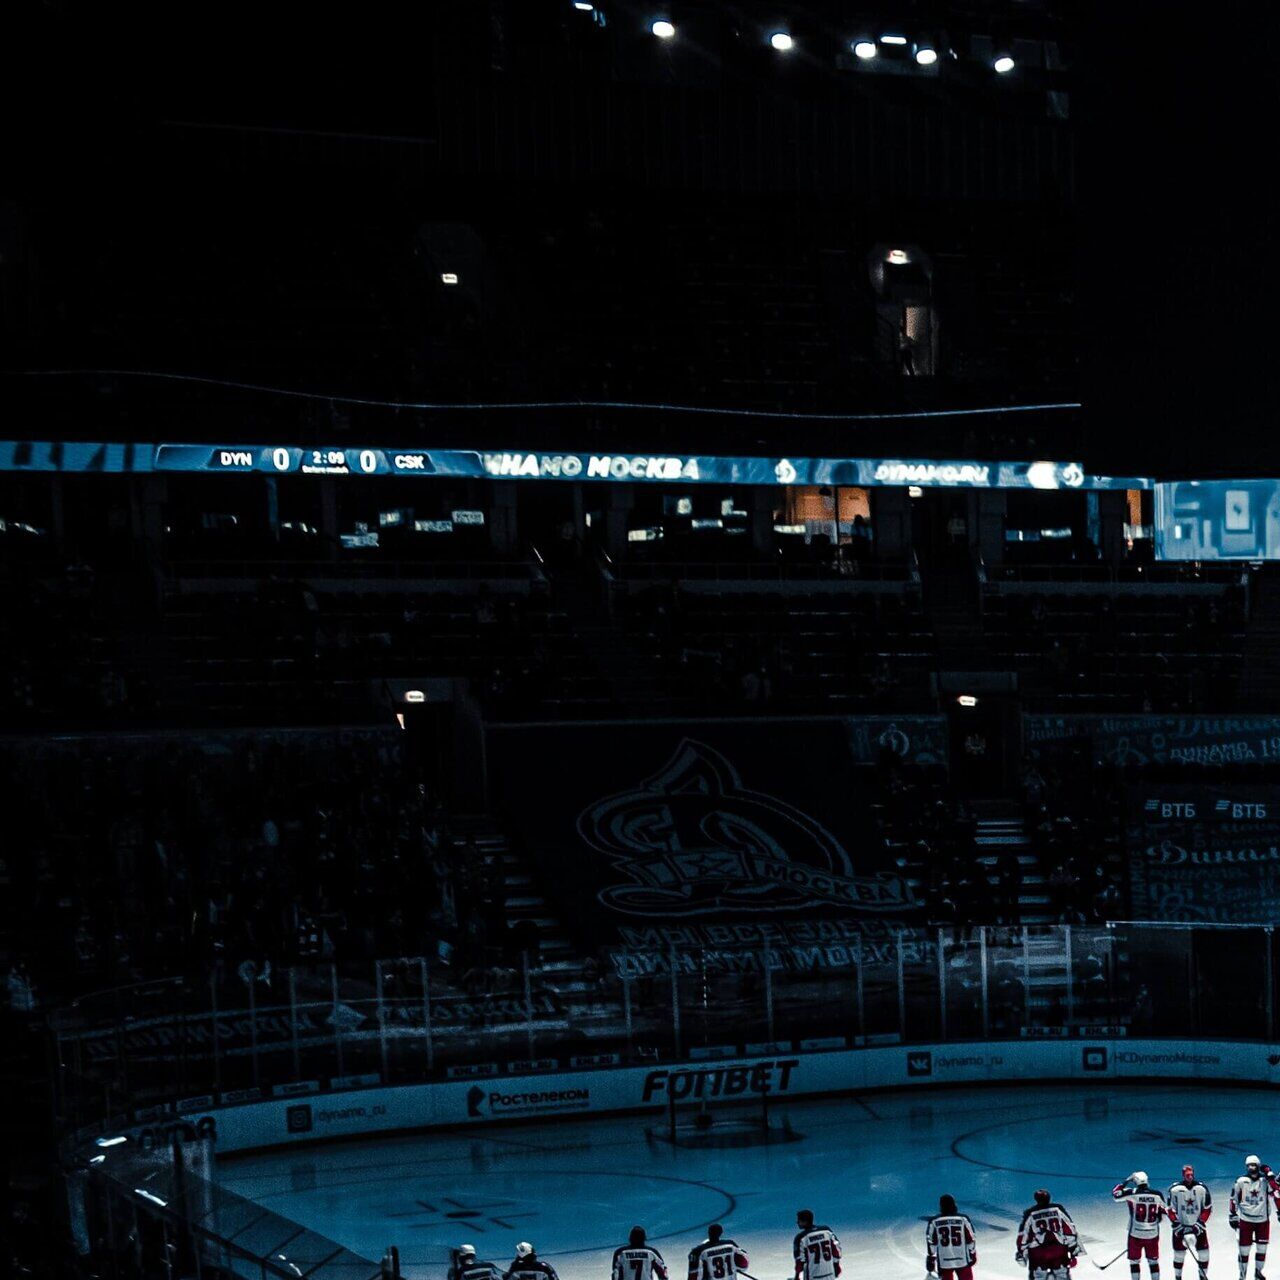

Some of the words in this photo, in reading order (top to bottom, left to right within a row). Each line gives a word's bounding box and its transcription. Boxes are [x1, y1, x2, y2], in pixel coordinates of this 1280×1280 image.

[220, 452, 252, 466] DYN
[272, 448, 290, 471] 0
[312, 451, 346, 464] 2:09
[359, 450, 376, 472] 0
[395, 455, 424, 469] CSK
[586, 456, 699, 479] МОСКВА
[1161, 803, 1196, 818] ВТБ
[1232, 803, 1267, 818] ВТБ
[489, 1088, 590, 1107] Ростелеком
[938, 1226, 962, 1246] 35
[807, 1240, 832, 1264] 75
[711, 1257, 733, 1279] 31
